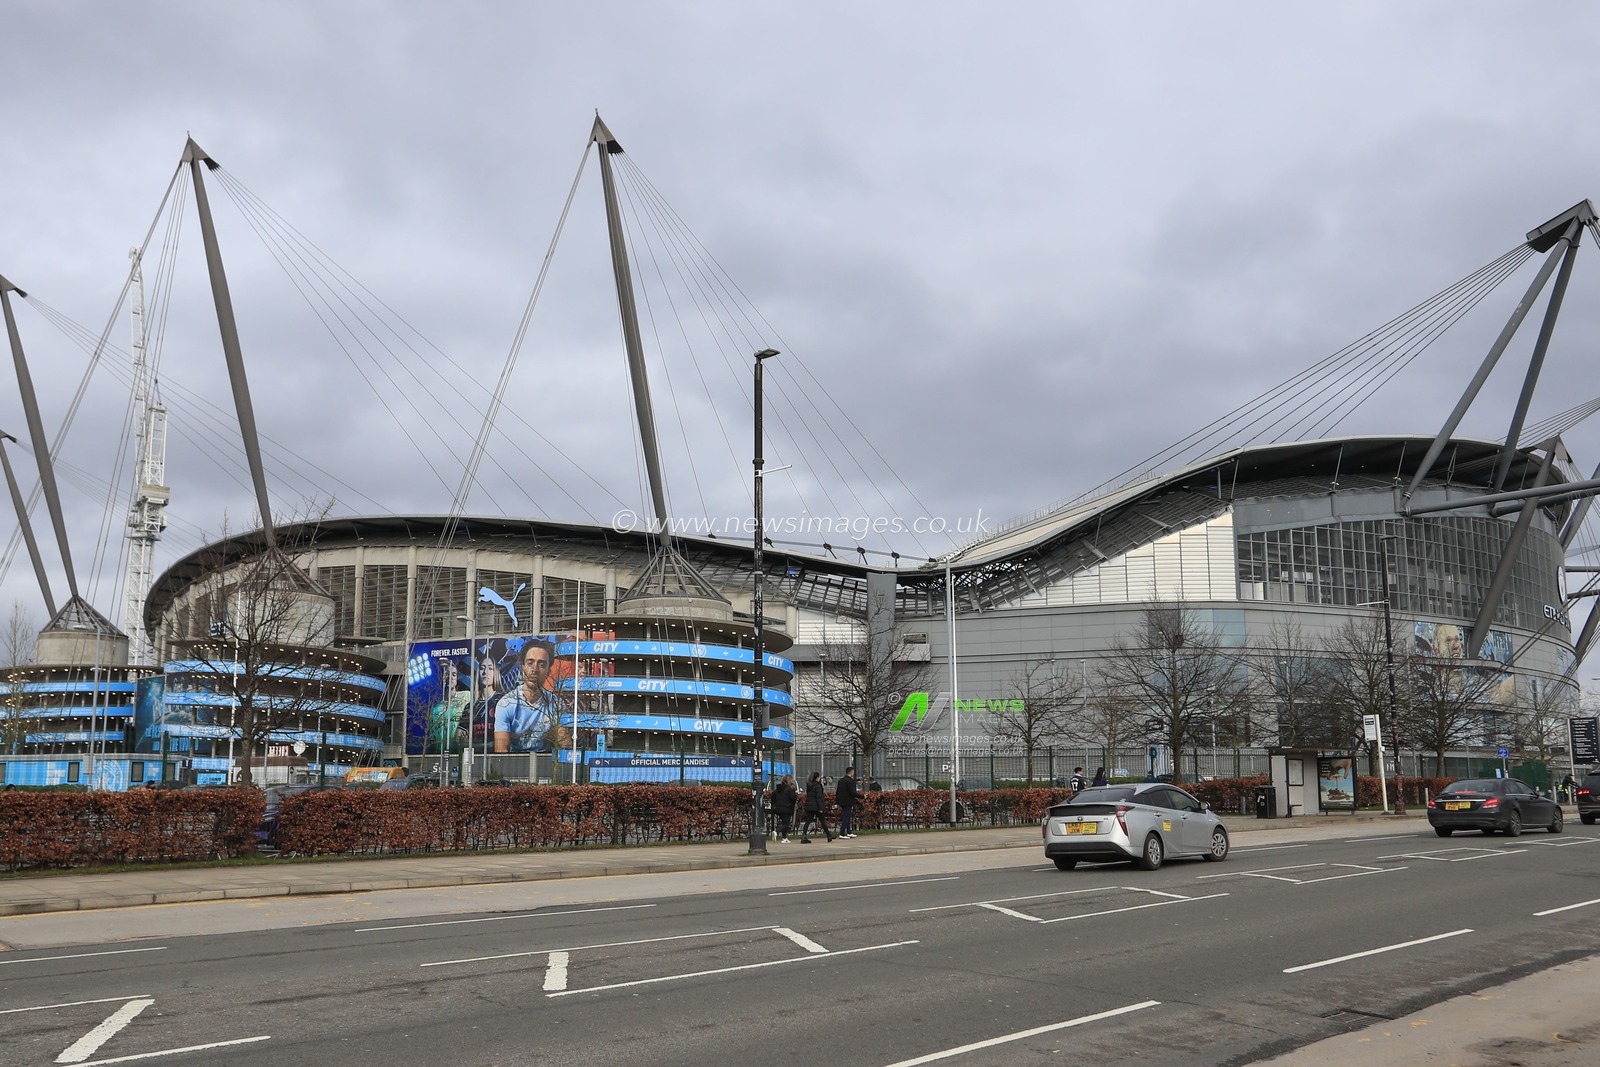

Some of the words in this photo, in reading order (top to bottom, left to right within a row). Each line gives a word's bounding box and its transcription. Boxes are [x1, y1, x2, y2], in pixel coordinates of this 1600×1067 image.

[430, 649, 452, 657] FOREVER.
[451, 647, 470, 656] FASTER.
[593, 642, 619, 652] CITY
[768, 655, 785, 667] CITY
[637, 680, 669, 691] CITY
[693, 720, 724, 732] CITY
